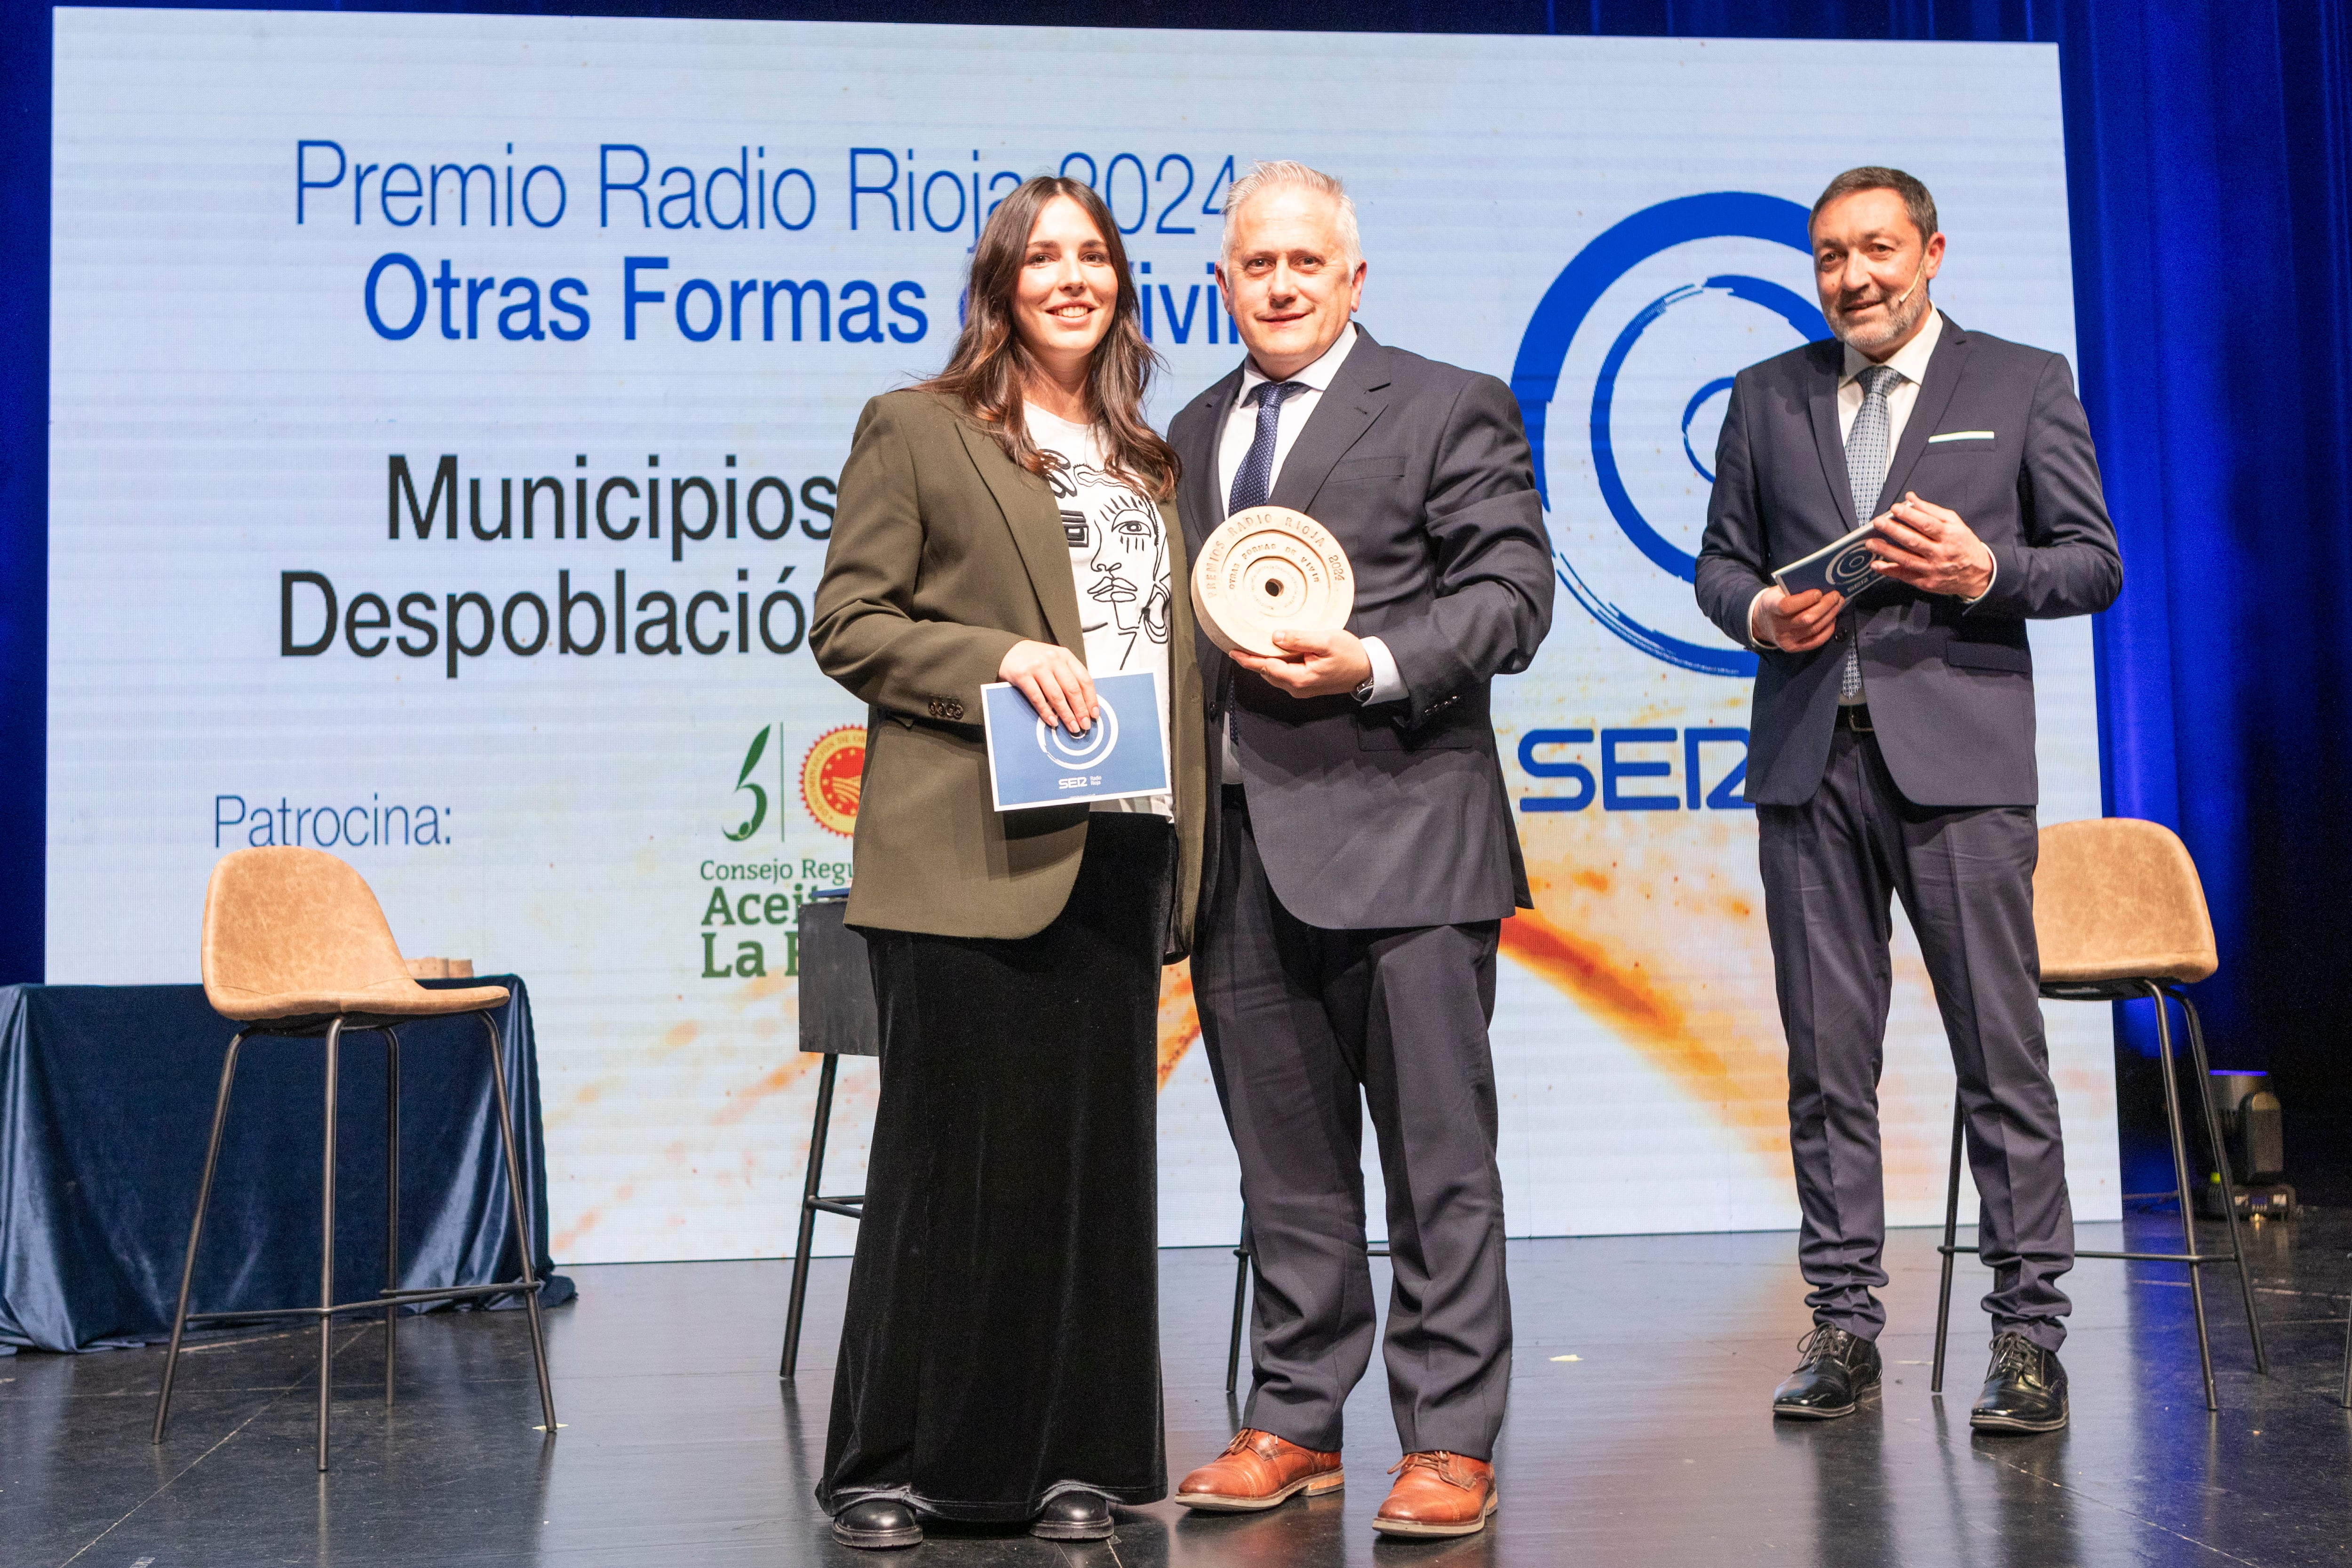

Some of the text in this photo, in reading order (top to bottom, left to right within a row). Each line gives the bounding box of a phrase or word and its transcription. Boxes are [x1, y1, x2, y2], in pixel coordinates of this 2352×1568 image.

[297, 140, 567, 229] Premio
[600, 143, 816, 231] Radio
[365, 252, 591, 342] Otras
[624, 256, 929, 344] Formas
[388, 454, 838, 562] Municipios
[1227, 514, 1272, 538] RADIO
[1285, 517, 1325, 547] RIOJA
[1328, 555, 1345, 581] 2024
[280, 565, 817, 679] Despoblació
[1058, 776, 1088, 789] SER
[1518, 727, 1756, 812] SER
[215, 792, 452, 848] Patrocina:
[700, 858, 793, 884] Consejo
[701, 931, 766, 978] La
